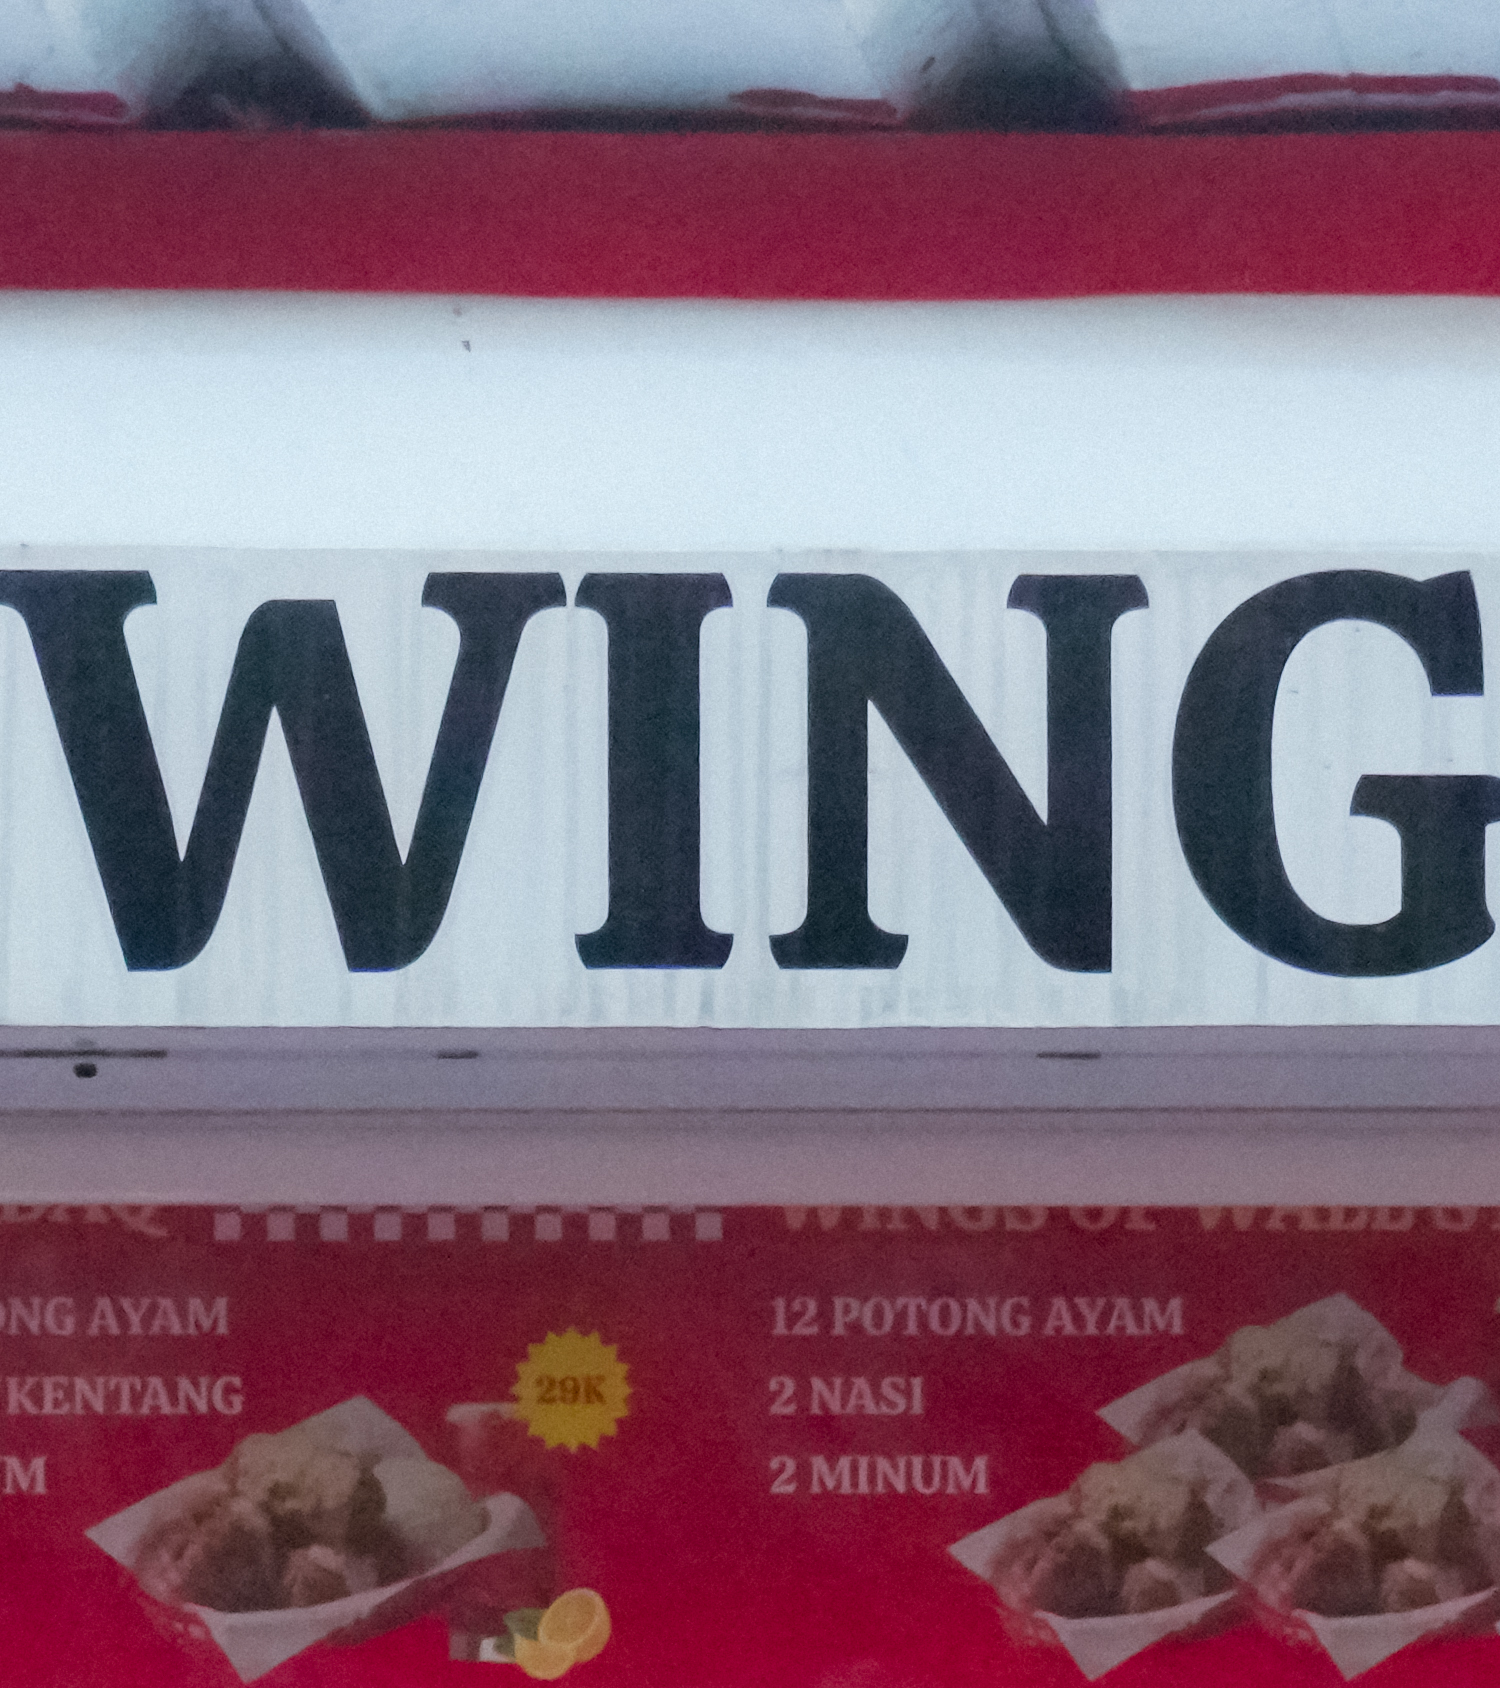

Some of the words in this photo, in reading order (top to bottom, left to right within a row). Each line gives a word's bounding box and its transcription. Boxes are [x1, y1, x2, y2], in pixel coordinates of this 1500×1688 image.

[88, 1296, 230, 1336] AYAM
[770, 1298, 820, 1335] 12
[832, 1297, 1033, 1337] POTONG
[1043, 1298, 1185, 1336] AYAM
[537, 1375, 606, 1405] 29K
[769, 1377, 796, 1414] 2
[809, 1377, 924, 1415] NASI
[769, 1458, 796, 1495] 2
[809, 1457, 989, 1495] MINUM
